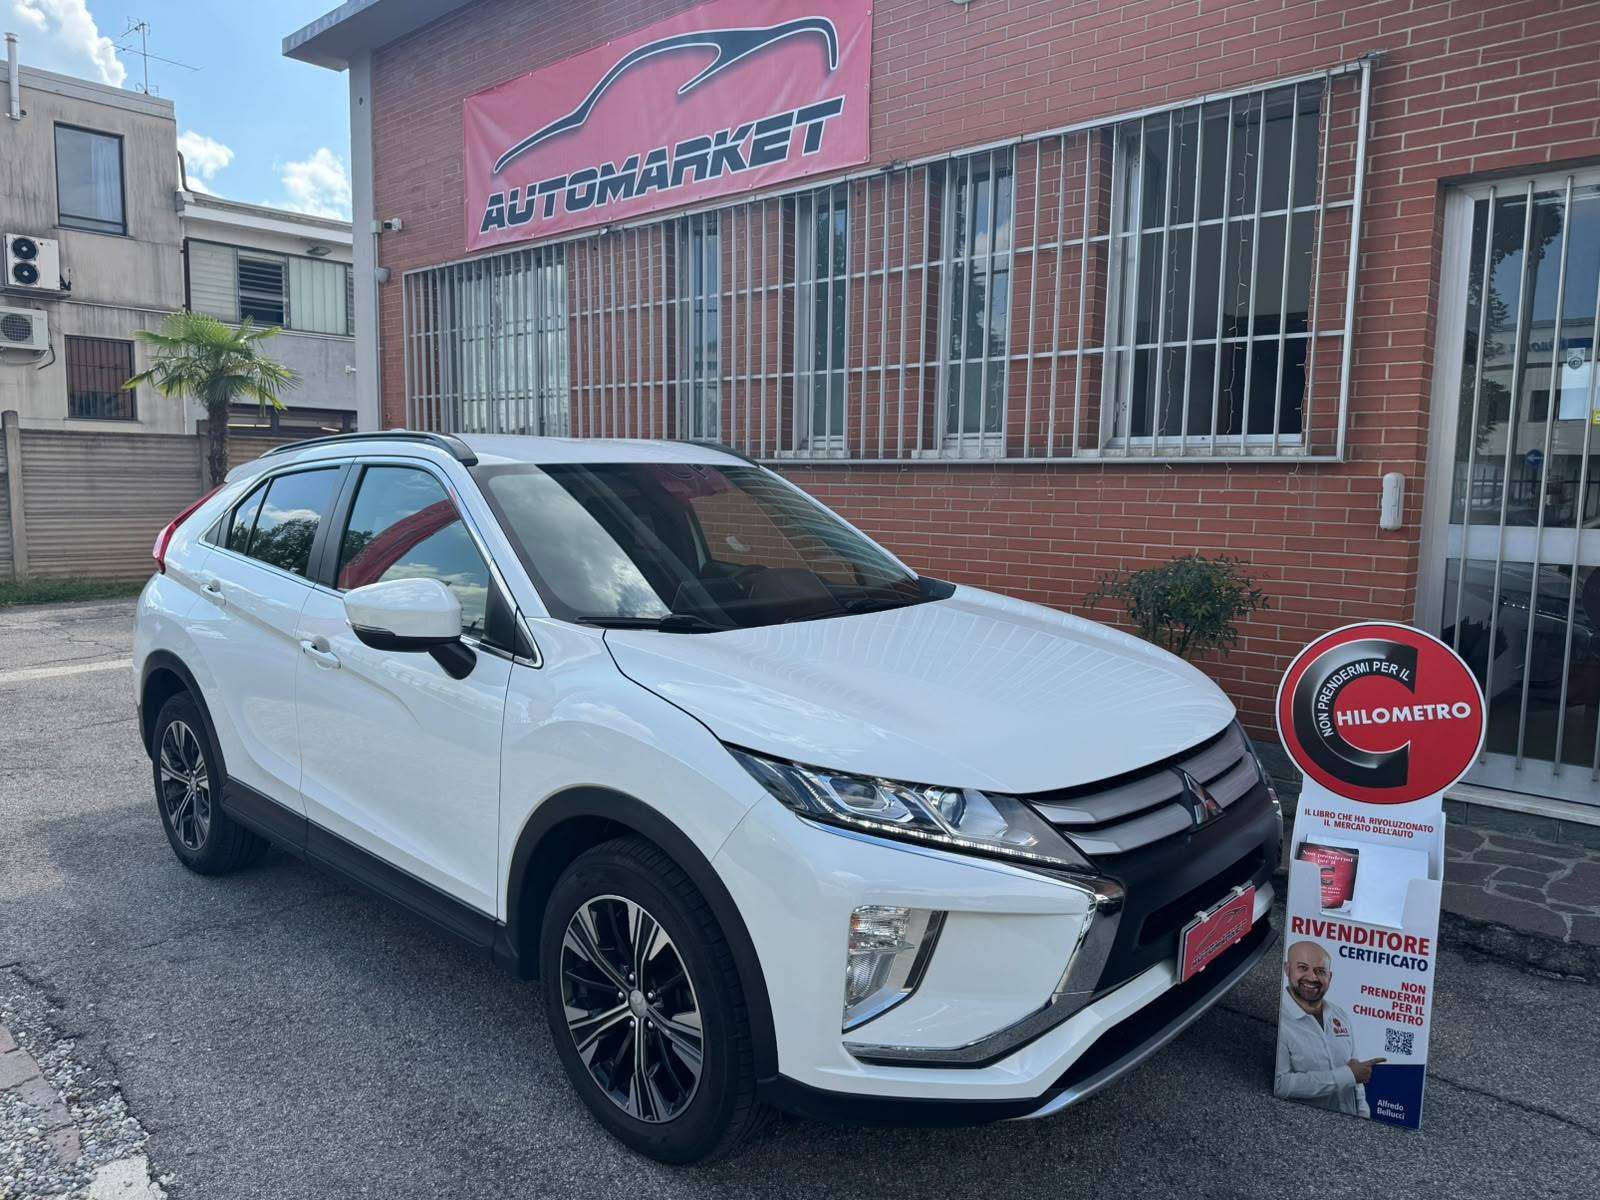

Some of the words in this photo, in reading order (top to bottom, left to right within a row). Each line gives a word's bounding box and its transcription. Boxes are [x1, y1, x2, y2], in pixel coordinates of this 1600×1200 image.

[479, 94, 846, 234] AUTOMARKET
[1373, 661, 1398, 674] PER
[1399, 669, 1411, 682] IL
[1318, 661, 1371, 707] PRENDERMI
[1318, 708, 1334, 737] NON
[1336, 701, 1471, 726] HILOMETRO
[1304, 808, 1312, 816] IL
[1312, 810, 1336, 819] LIBRO
[1337, 812, 1353, 822] CHE
[1354, 815, 1366, 824] HA
[1368, 817, 1434, 833] RIVOLUZIONATO
[1323, 819, 1331, 827] IL
[1333, 820, 1371, 832] MERCATO
[1372, 825, 1414, 838] DELL'AUTO
[1291, 915, 1430, 956] RIVENDITORE
[1339, 945, 1429, 972] CERTIFICATO
[1360, 985, 1426, 1006] PRENDERMI
[1401, 982, 1426, 994] NON
[1353, 1004, 1424, 1026] CHILOMETRO
[1391, 1001, 1412, 1014] PER
[1415, 1005, 1425, 1016] IL
[1376, 1099, 1404, 1111] Alfredo
[1376, 1107, 1405, 1120] Bellucci
